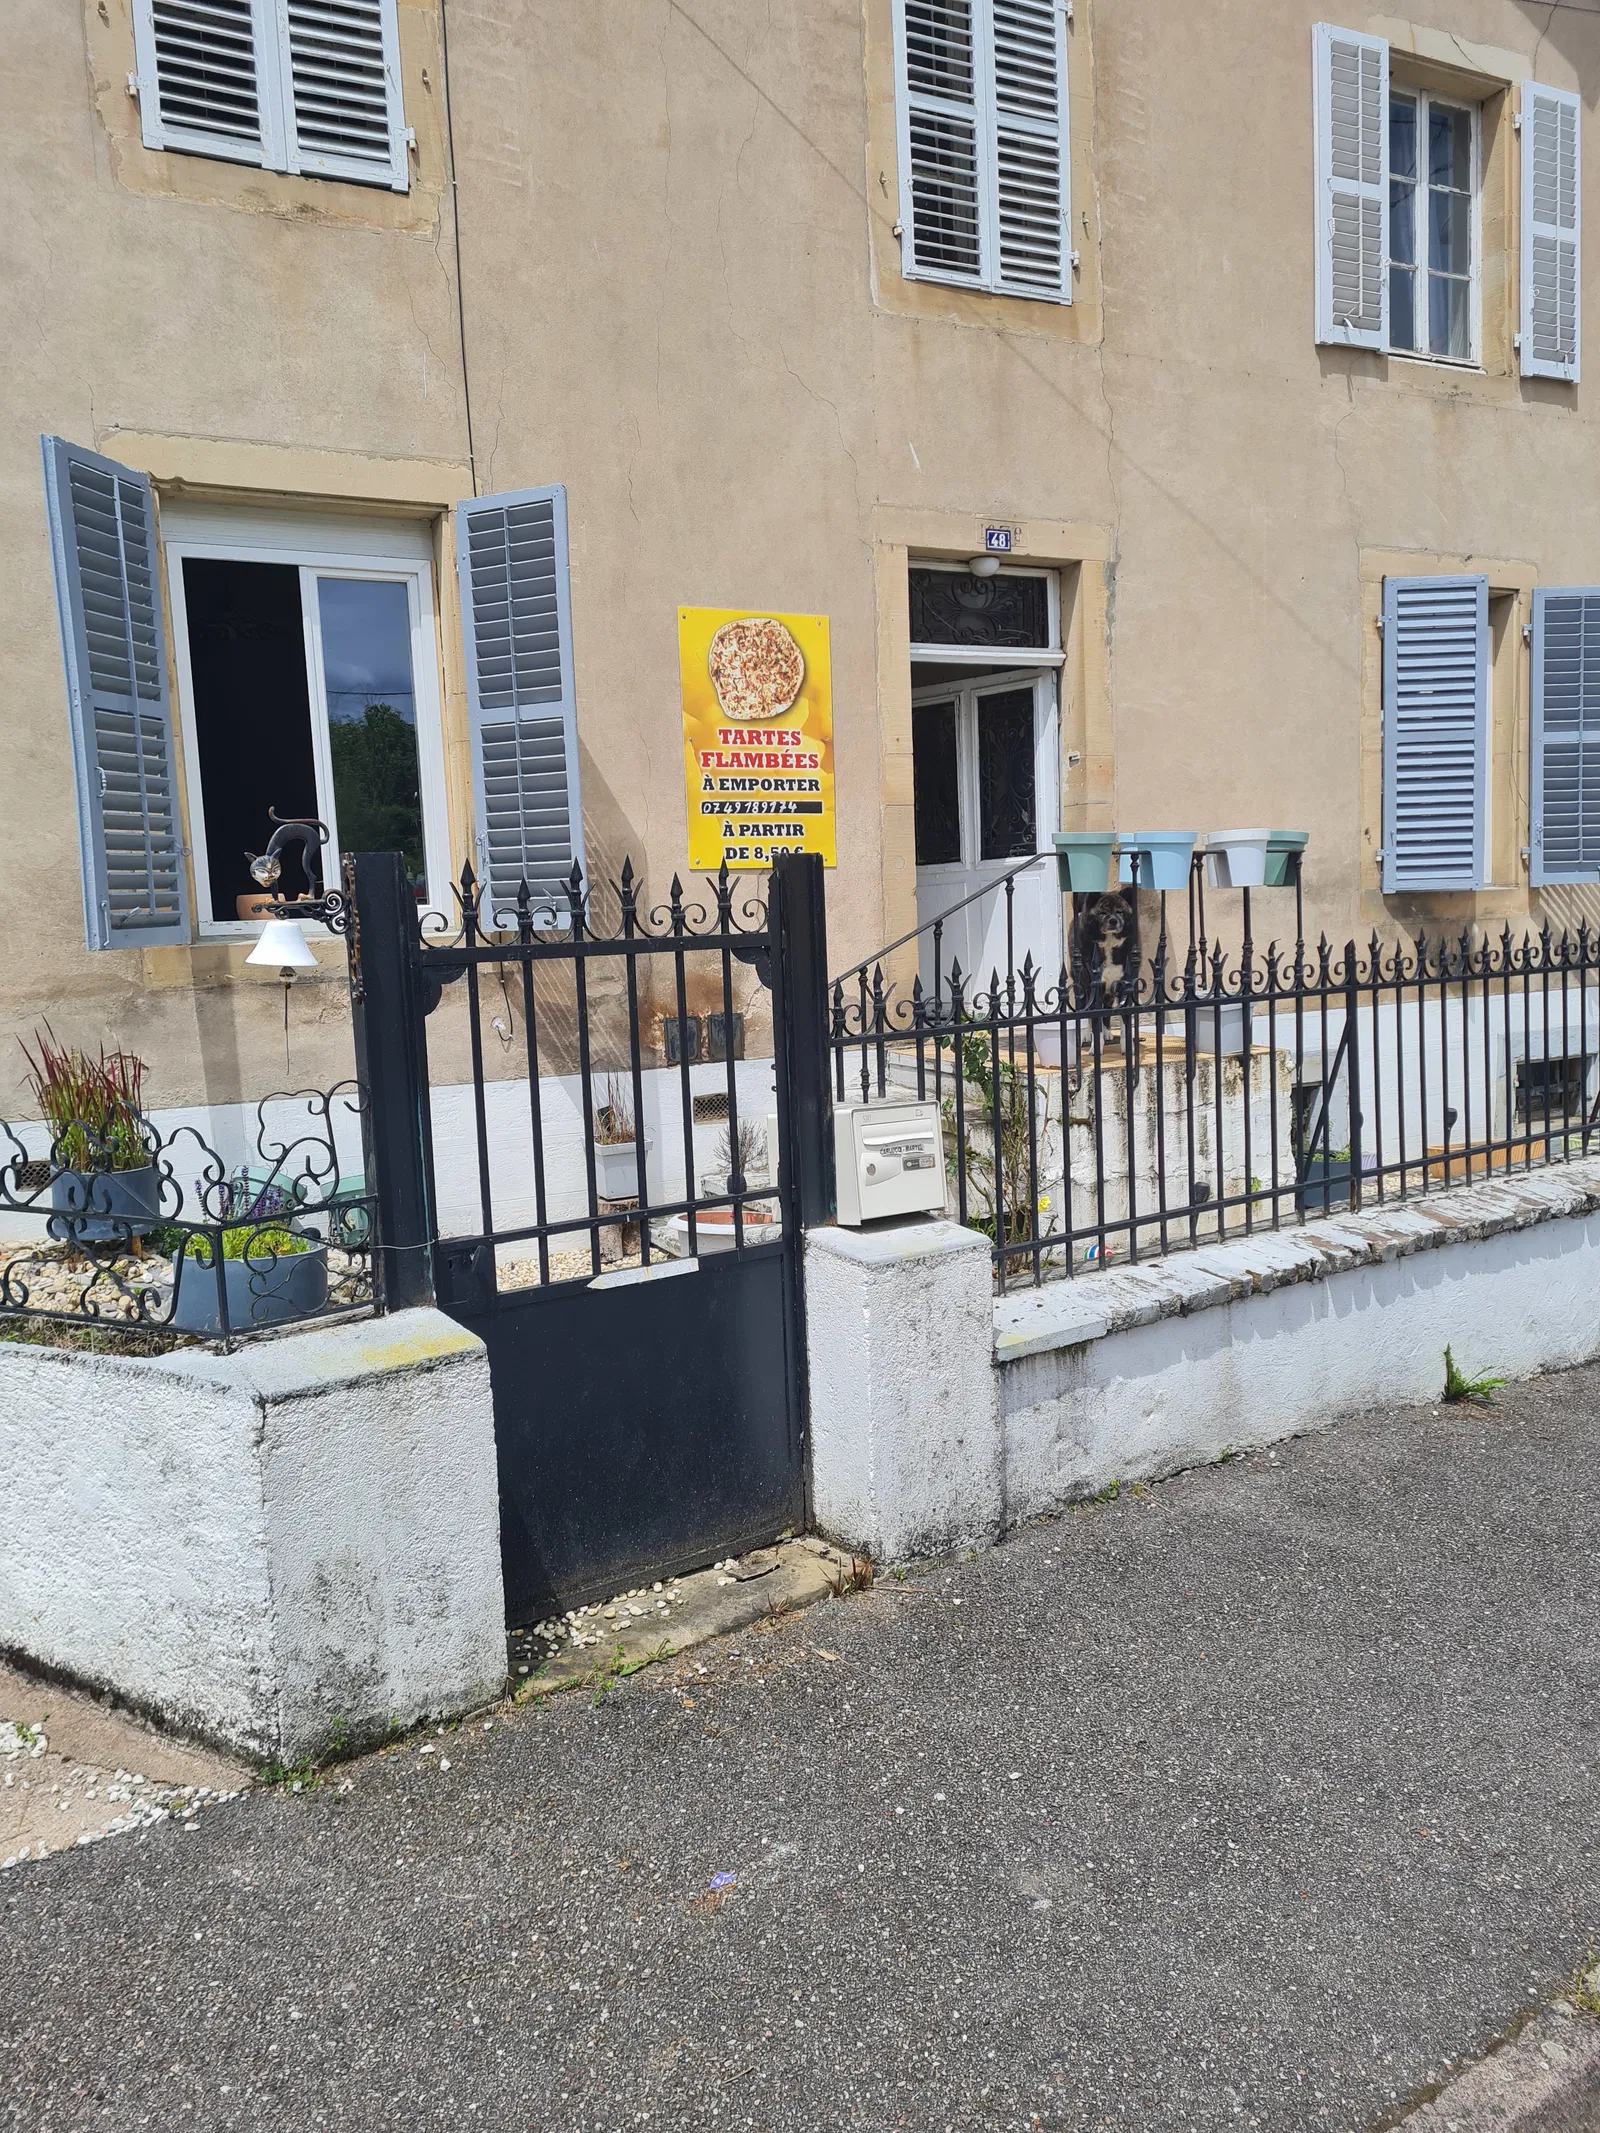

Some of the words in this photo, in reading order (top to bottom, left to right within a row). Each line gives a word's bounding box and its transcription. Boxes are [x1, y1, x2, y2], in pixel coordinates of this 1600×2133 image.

[991, 533, 1006, 547] 48
[718, 729, 801, 746] TARTES
[701, 749, 819, 769] FLAMBÉES
[702, 774, 714, 791] À
[719, 778, 820, 792] EMPORTER
[723, 821, 735, 837] À
[738, 824, 805, 837] PARTIR
[725, 847, 750, 860] DE
